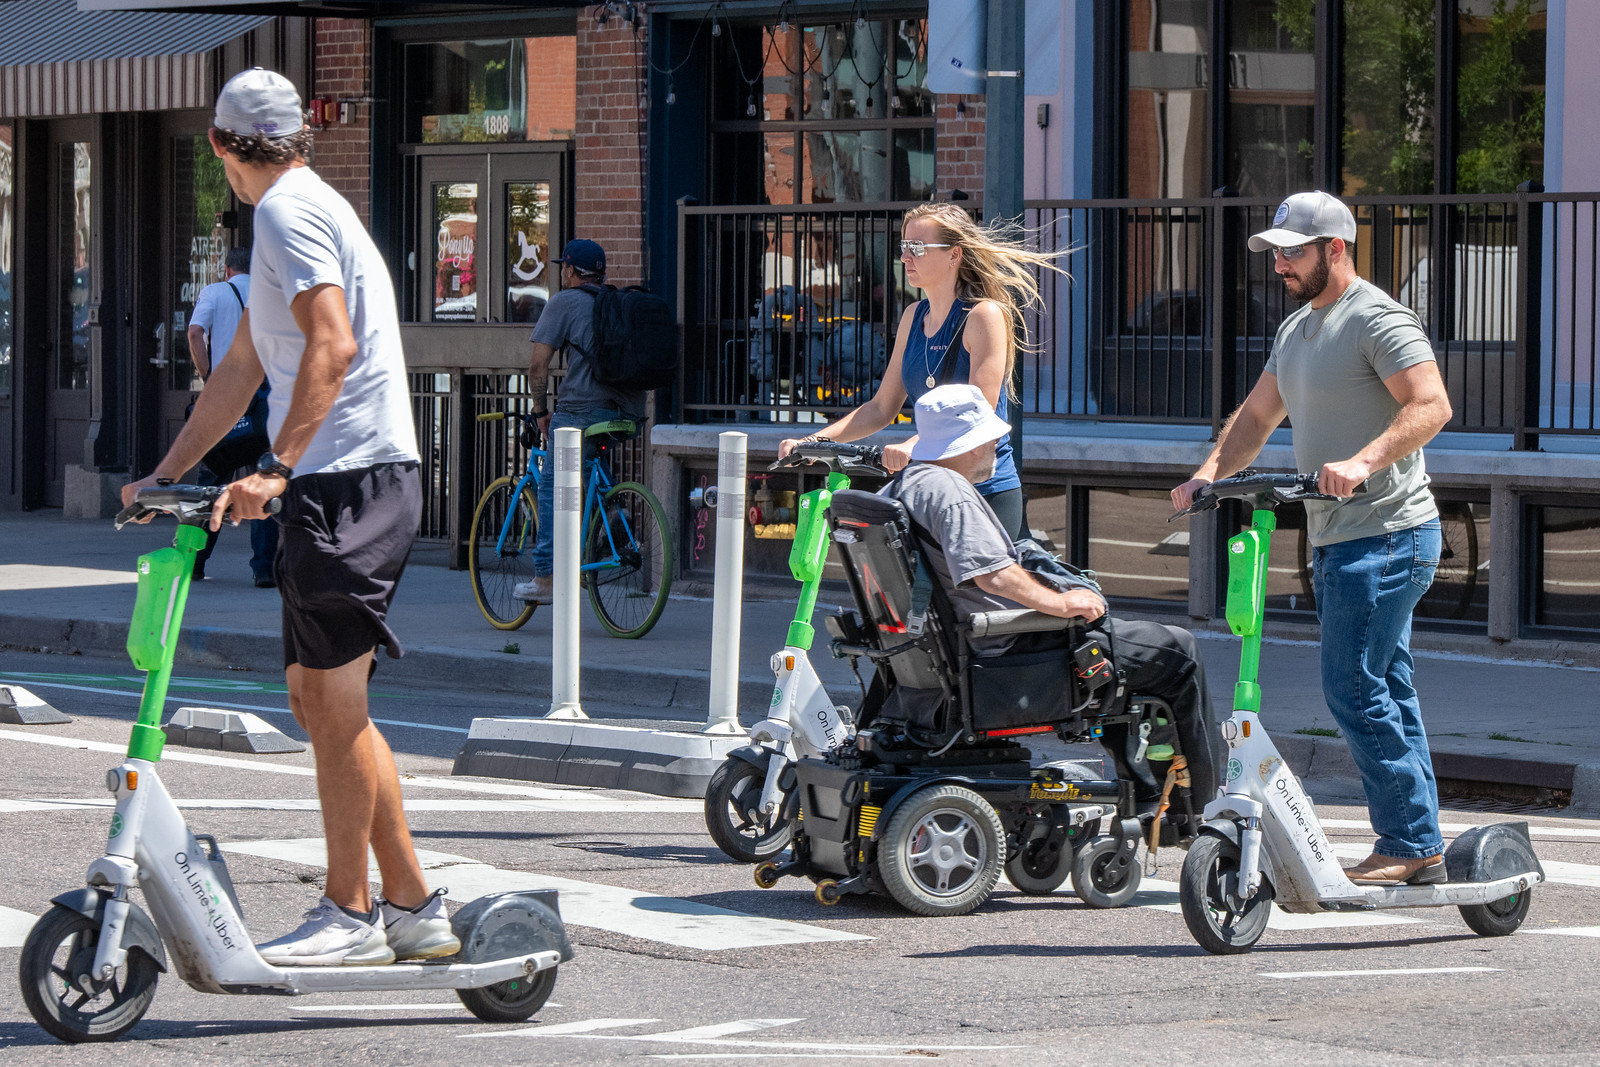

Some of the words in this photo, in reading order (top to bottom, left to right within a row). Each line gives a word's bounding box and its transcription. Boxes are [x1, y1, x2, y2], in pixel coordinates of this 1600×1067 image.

[484, 115, 509, 134] 1808
[817, 710, 829, 728] On
[824, 727, 838, 749] Lim
[1275, 778, 1289, 799] On
[1285, 796, 1305, 826] Lime
[1307, 833, 1325, 863] Uber
[174, 851, 191, 874] On
[186, 872, 210, 907] Lime
[212, 916, 236, 950] Uber
